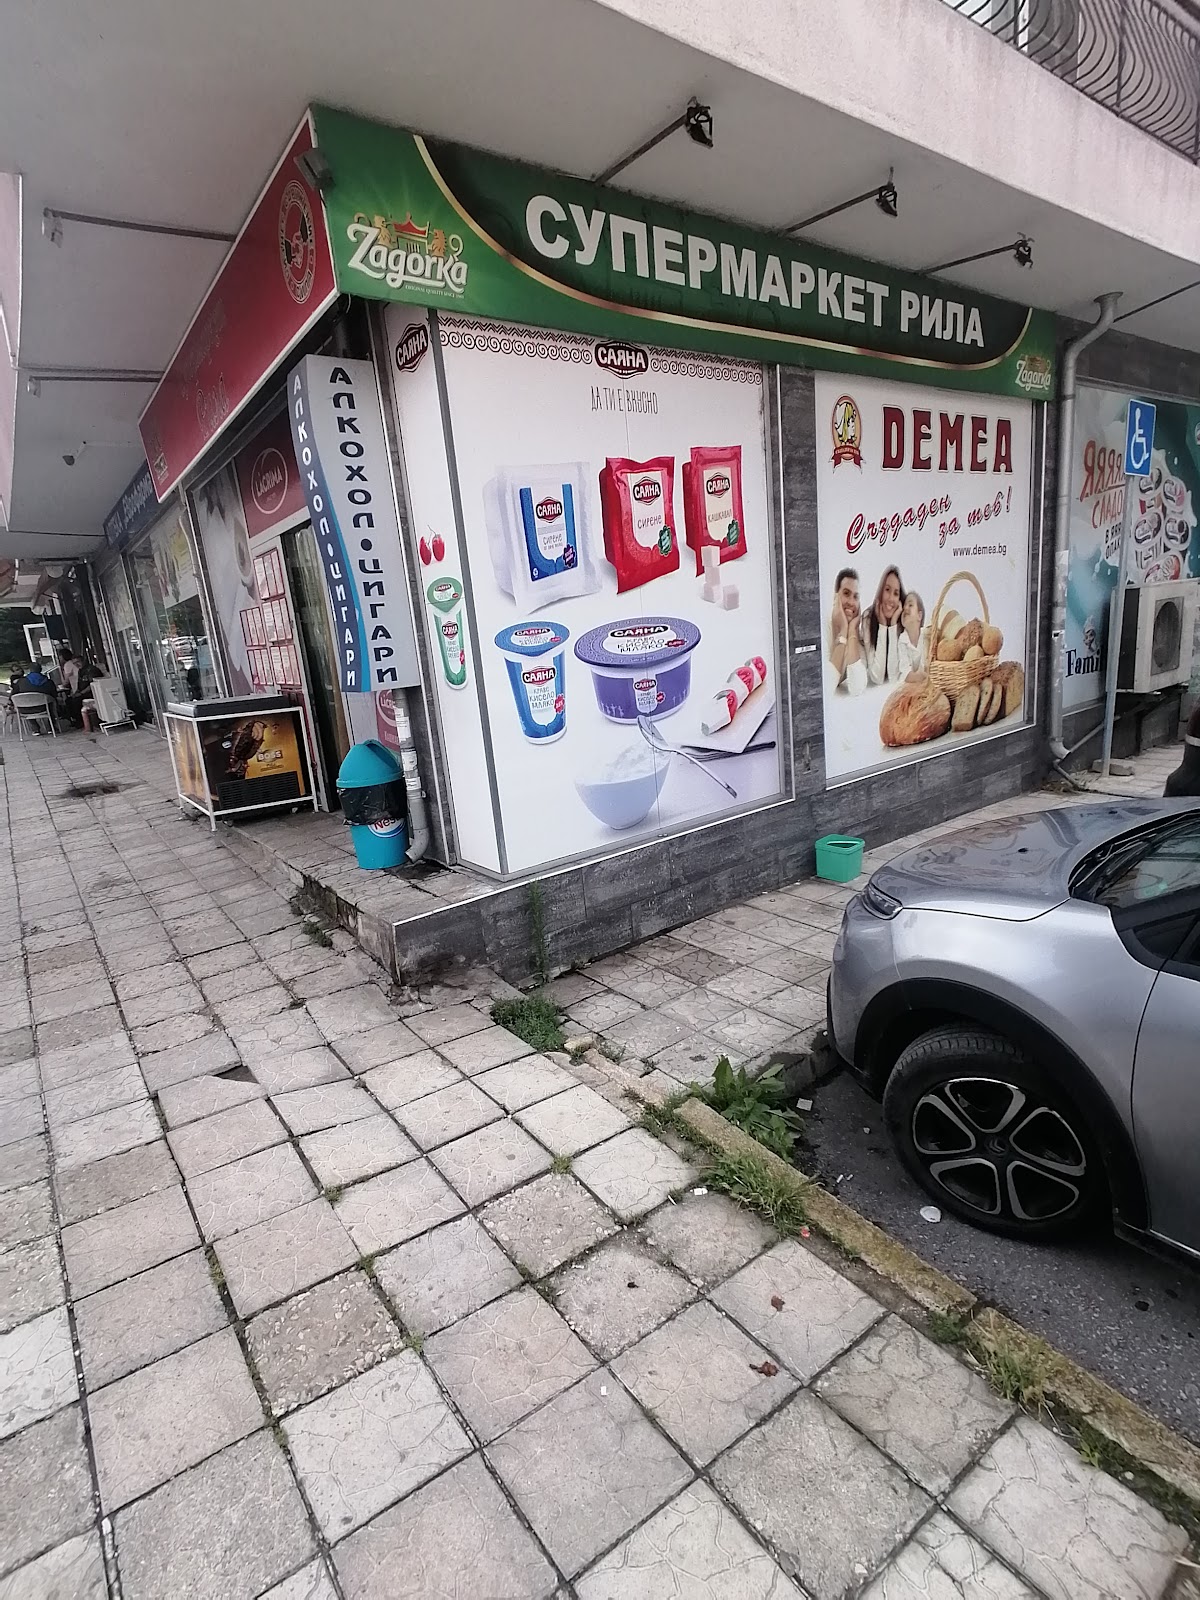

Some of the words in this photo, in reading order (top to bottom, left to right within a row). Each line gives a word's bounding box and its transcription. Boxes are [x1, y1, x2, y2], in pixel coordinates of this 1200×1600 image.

[347, 223, 468, 294] Zagorka
[525, 194, 890, 328] СУПЕРМАРКЕТ
[900, 289, 985, 348] РИЛА
[397, 329, 428, 366] САЯНА
[597, 346, 646, 369] САЯНА
[1015, 359, 1052, 391] Zagorka
[625, 389, 659, 415] ВКУСНО
[881, 405, 1013, 473] DEMEA
[634, 484, 660, 499] САЯНА
[707, 479, 730, 493] САЯНА
[536, 503, 562, 517] САЯНА
[845, 494, 952, 553] Създаден
[938, 517, 961, 548] за
[952, 543, 1008, 557] www.demea.bg
[613, 626, 665, 637] САЯНА
[523, 669, 555, 683] САЯНА
